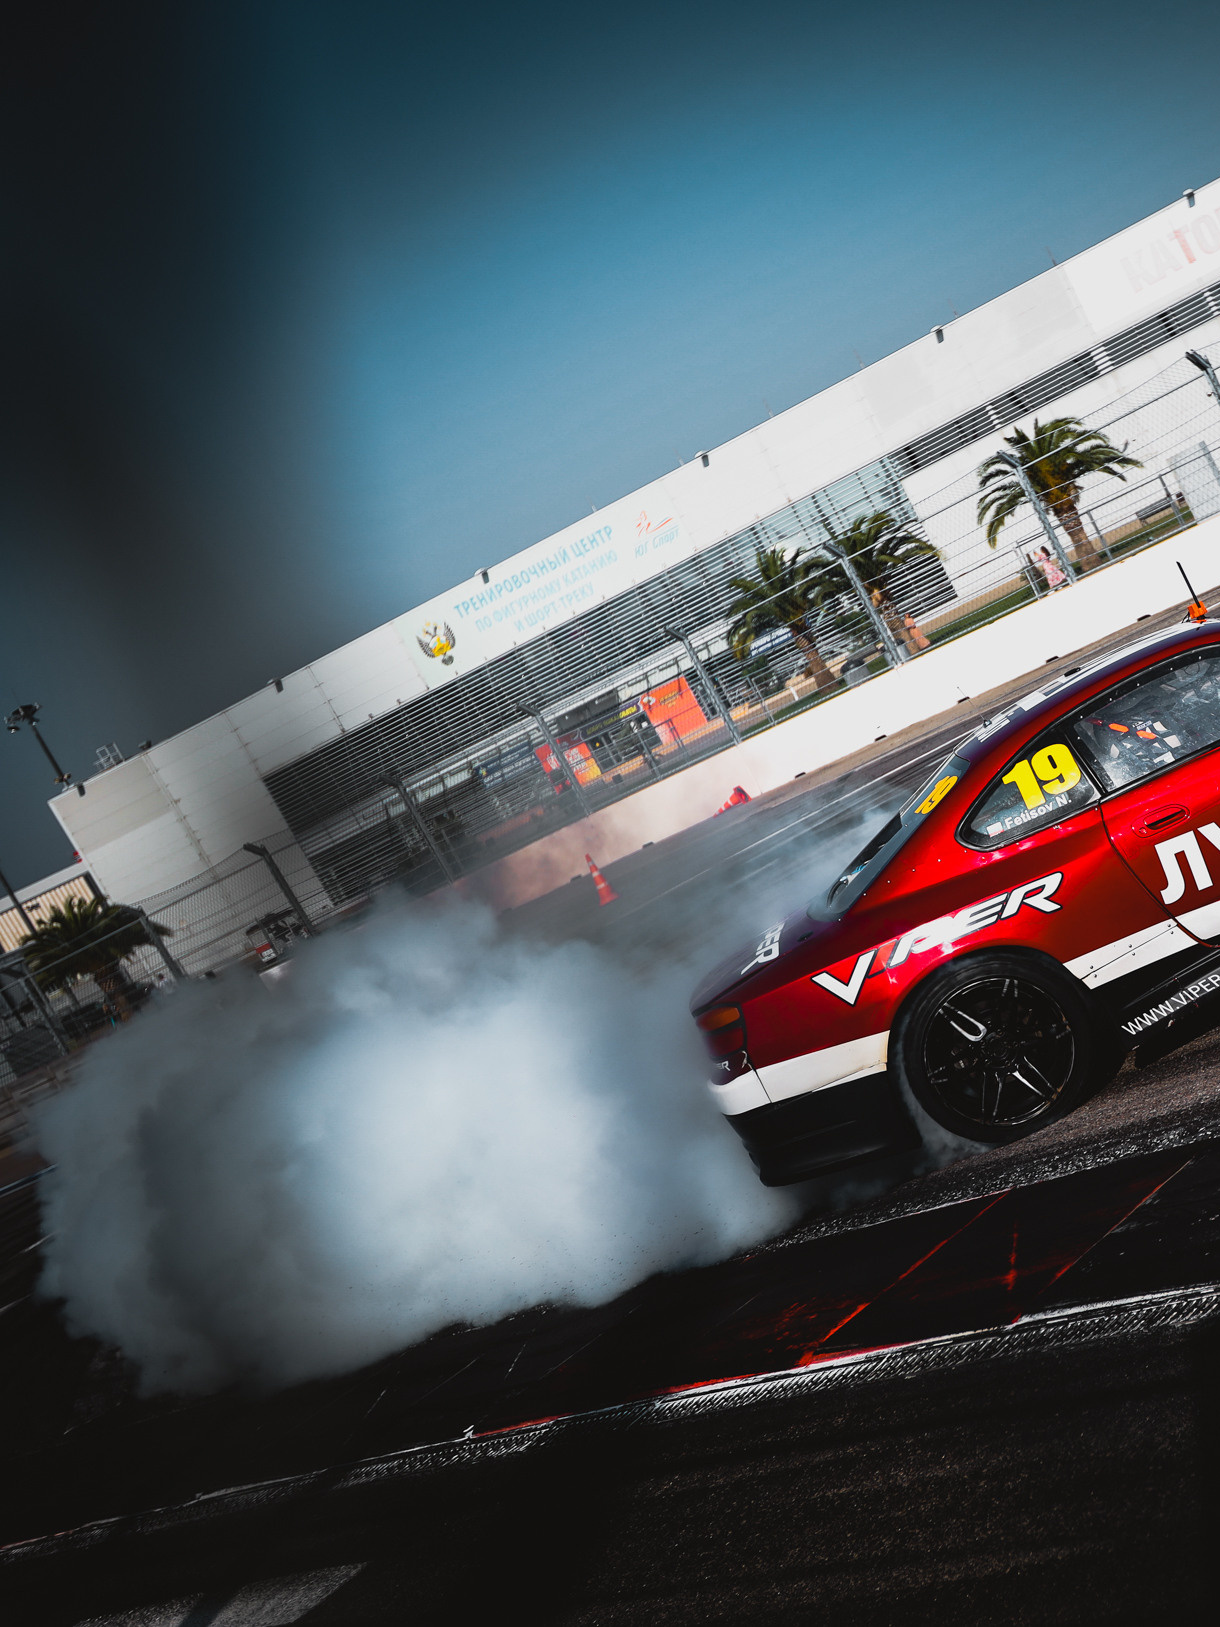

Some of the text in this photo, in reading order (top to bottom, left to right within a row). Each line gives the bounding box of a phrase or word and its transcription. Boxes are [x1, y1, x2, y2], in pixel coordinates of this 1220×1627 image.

[453, 524, 613, 619] ТРЕНИРОВОЧНЫЙ ЦЕНТР
[492, 578, 562, 623] ФИГУРНОМУ
[563, 549, 619, 588] КАТАНИЮ
[1001, 743, 1082, 810] 19
[1004, 794, 1072, 830] Fetisov N.
[810, 870, 1064, 1007] VIPER
